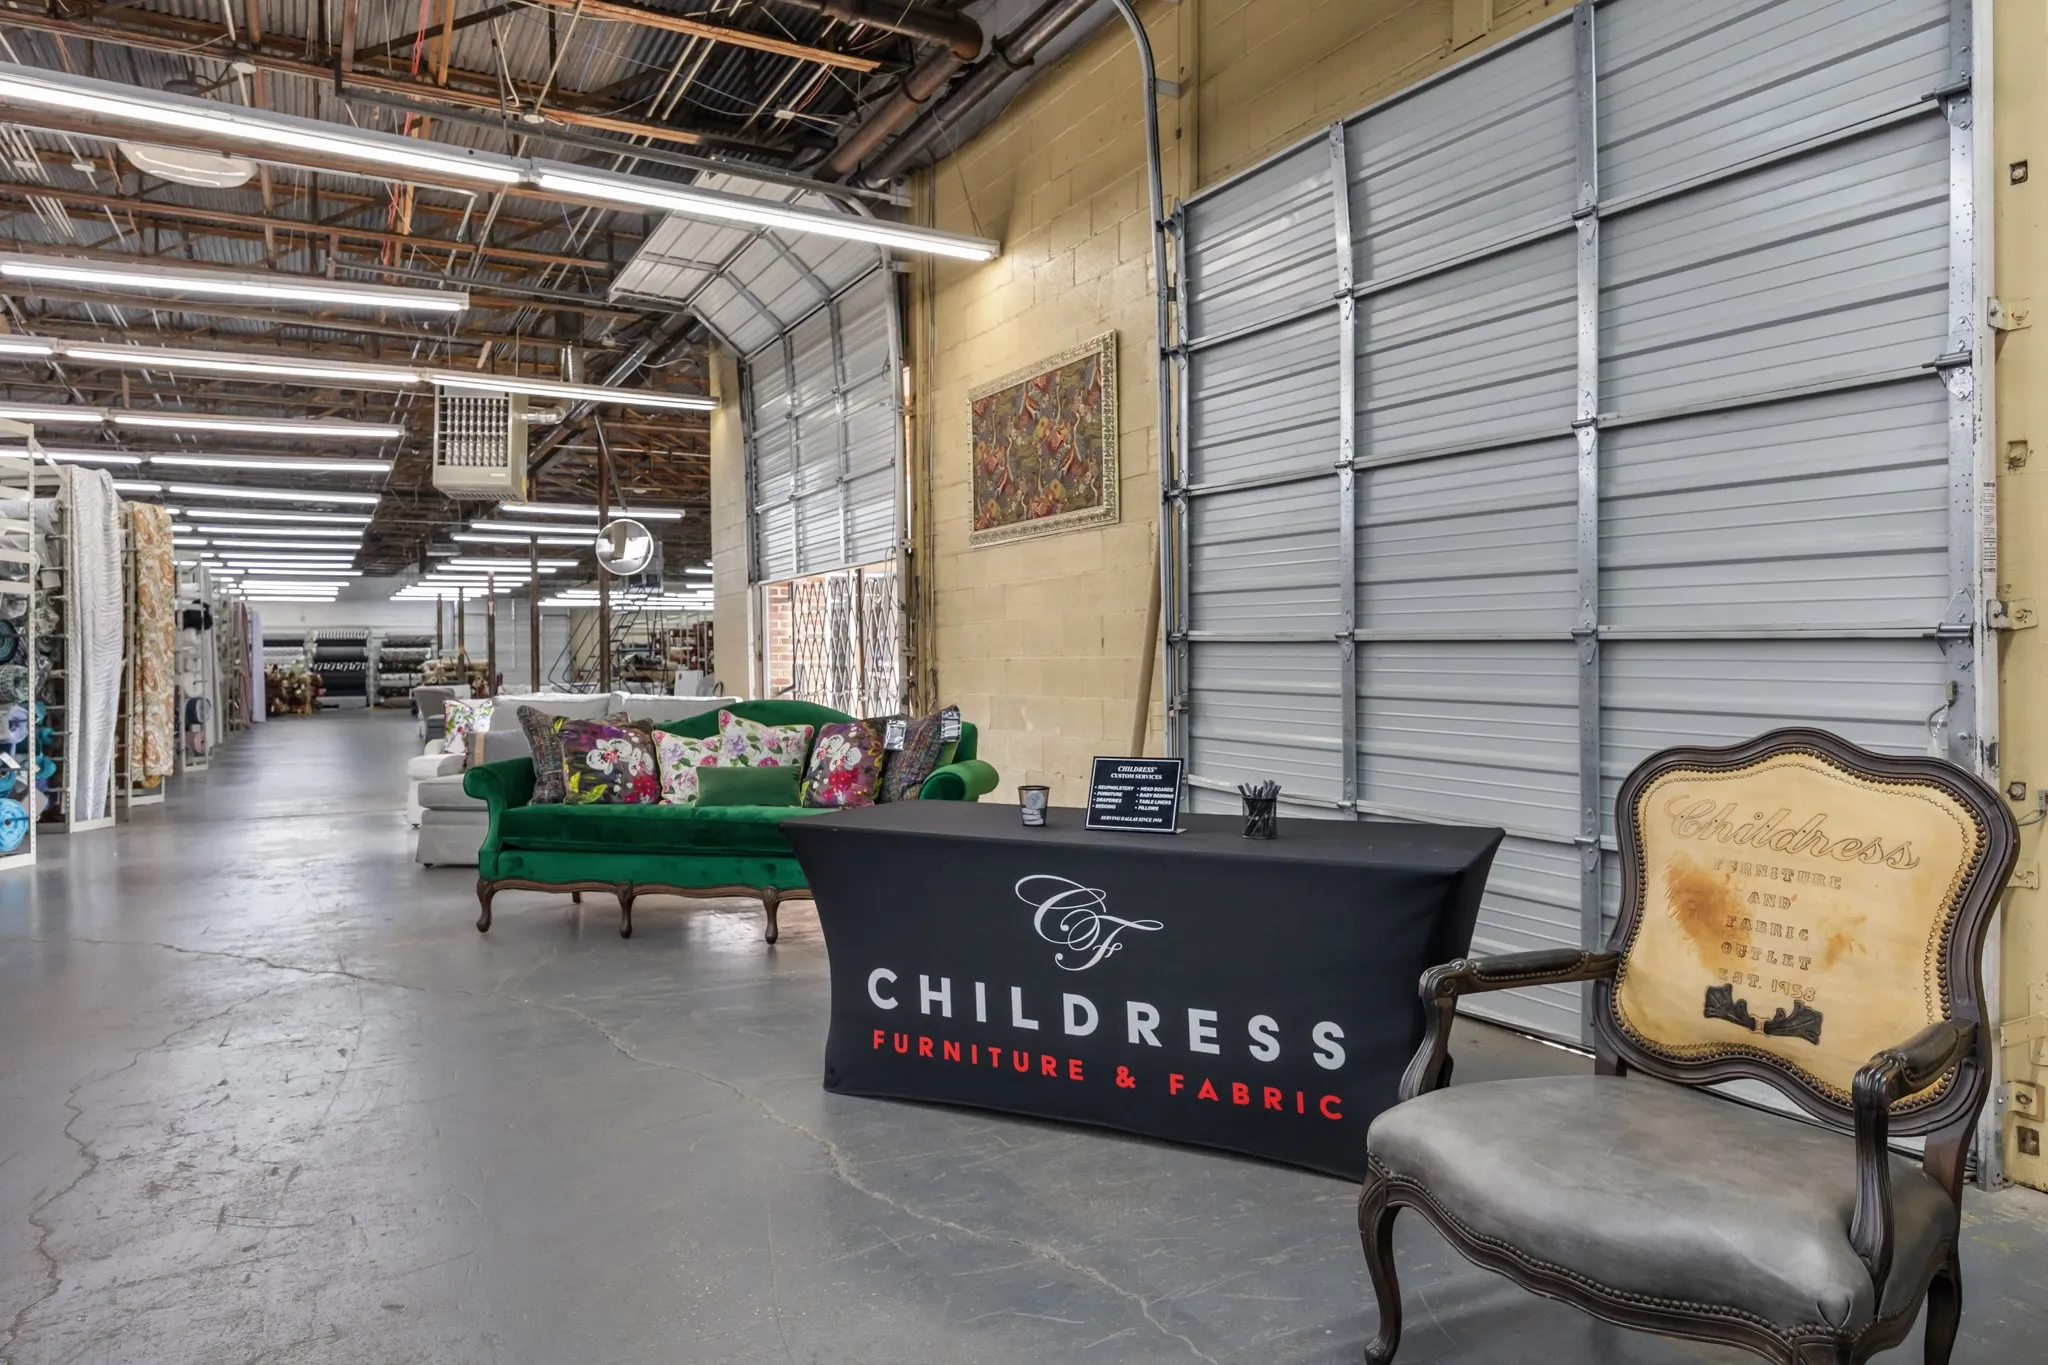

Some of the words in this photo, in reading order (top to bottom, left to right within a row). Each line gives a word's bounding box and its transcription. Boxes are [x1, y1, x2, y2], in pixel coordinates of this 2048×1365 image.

[1663, 794, 1921, 870] Childress
[1712, 858, 1843, 890] FURNITURE
[1746, 891, 1793, 911] AND
[1724, 914, 1810, 942] FABRIC
[1720, 940, 1812, 971] OUTLET
[1717, 967, 1762, 991] EST.
[1771, 978, 1817, 1003] 1958
[867, 967, 1346, 1071] CHILDRESS
[873, 1029, 1085, 1081] FURNITURE
[1115, 1065, 1136, 1089] &
[1169, 1073, 1344, 1121] FABRIC
